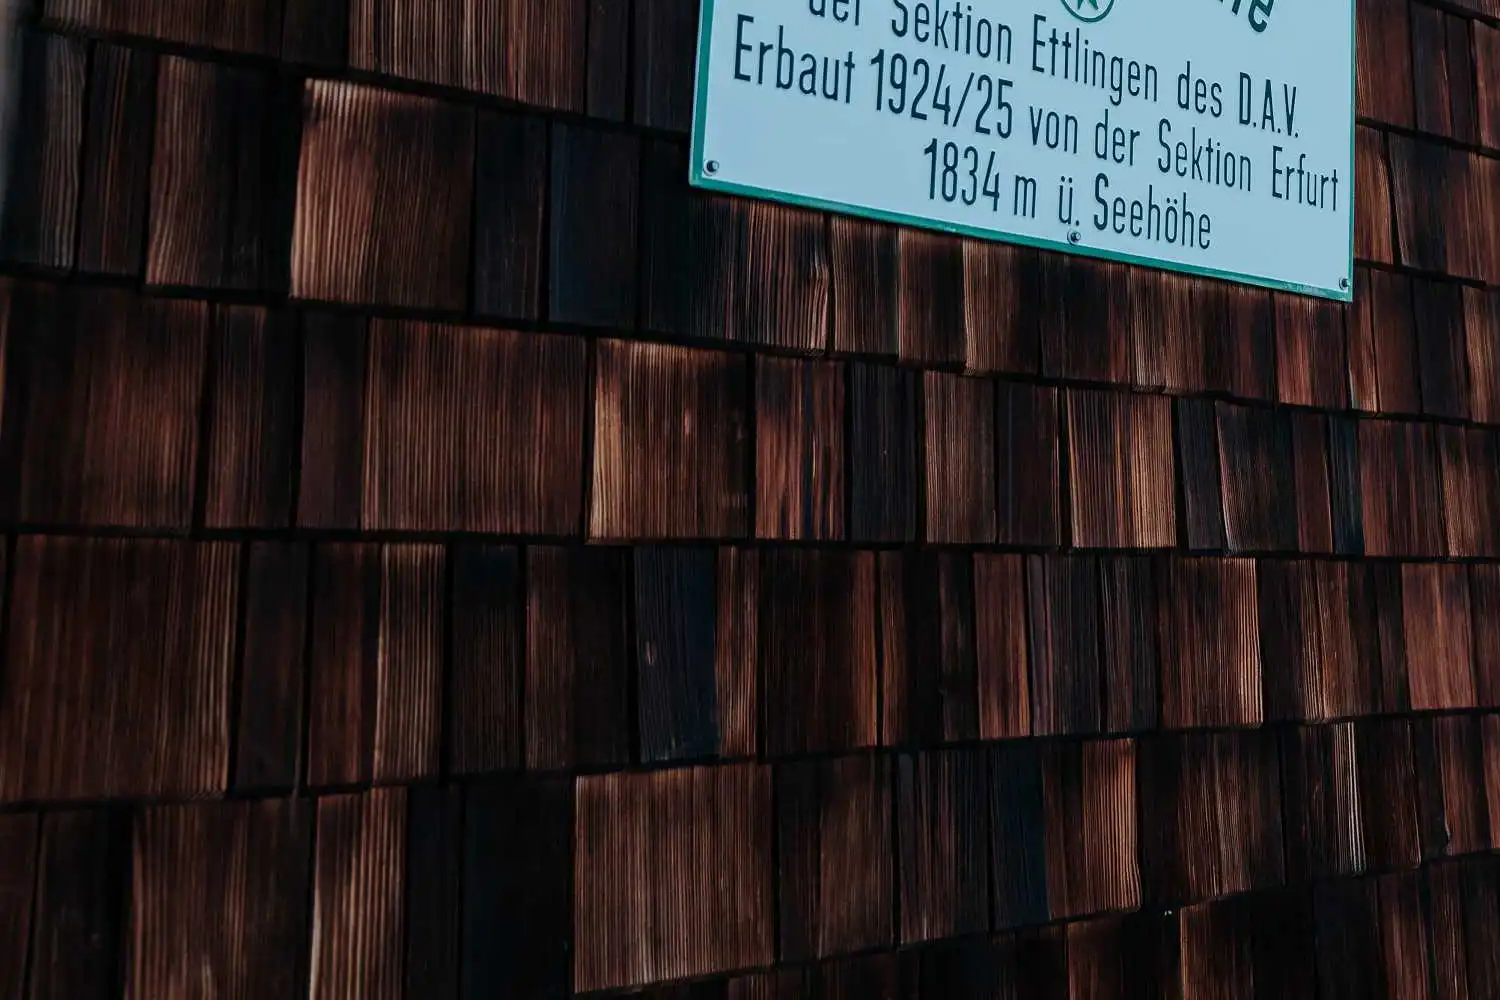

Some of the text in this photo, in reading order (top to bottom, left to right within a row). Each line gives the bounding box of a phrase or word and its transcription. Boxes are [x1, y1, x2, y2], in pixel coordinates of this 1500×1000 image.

[733, 13, 1339, 212] Erbaut 1924/25 von der Sektion Erfurt
[1031, 13, 1158, 107] Ettlingen
[1177, 60, 1223, 119] des
[1238, 71, 1299, 138] D.A.V.
[923, 137, 1212, 250] 1834 m ü. Seehöhe
